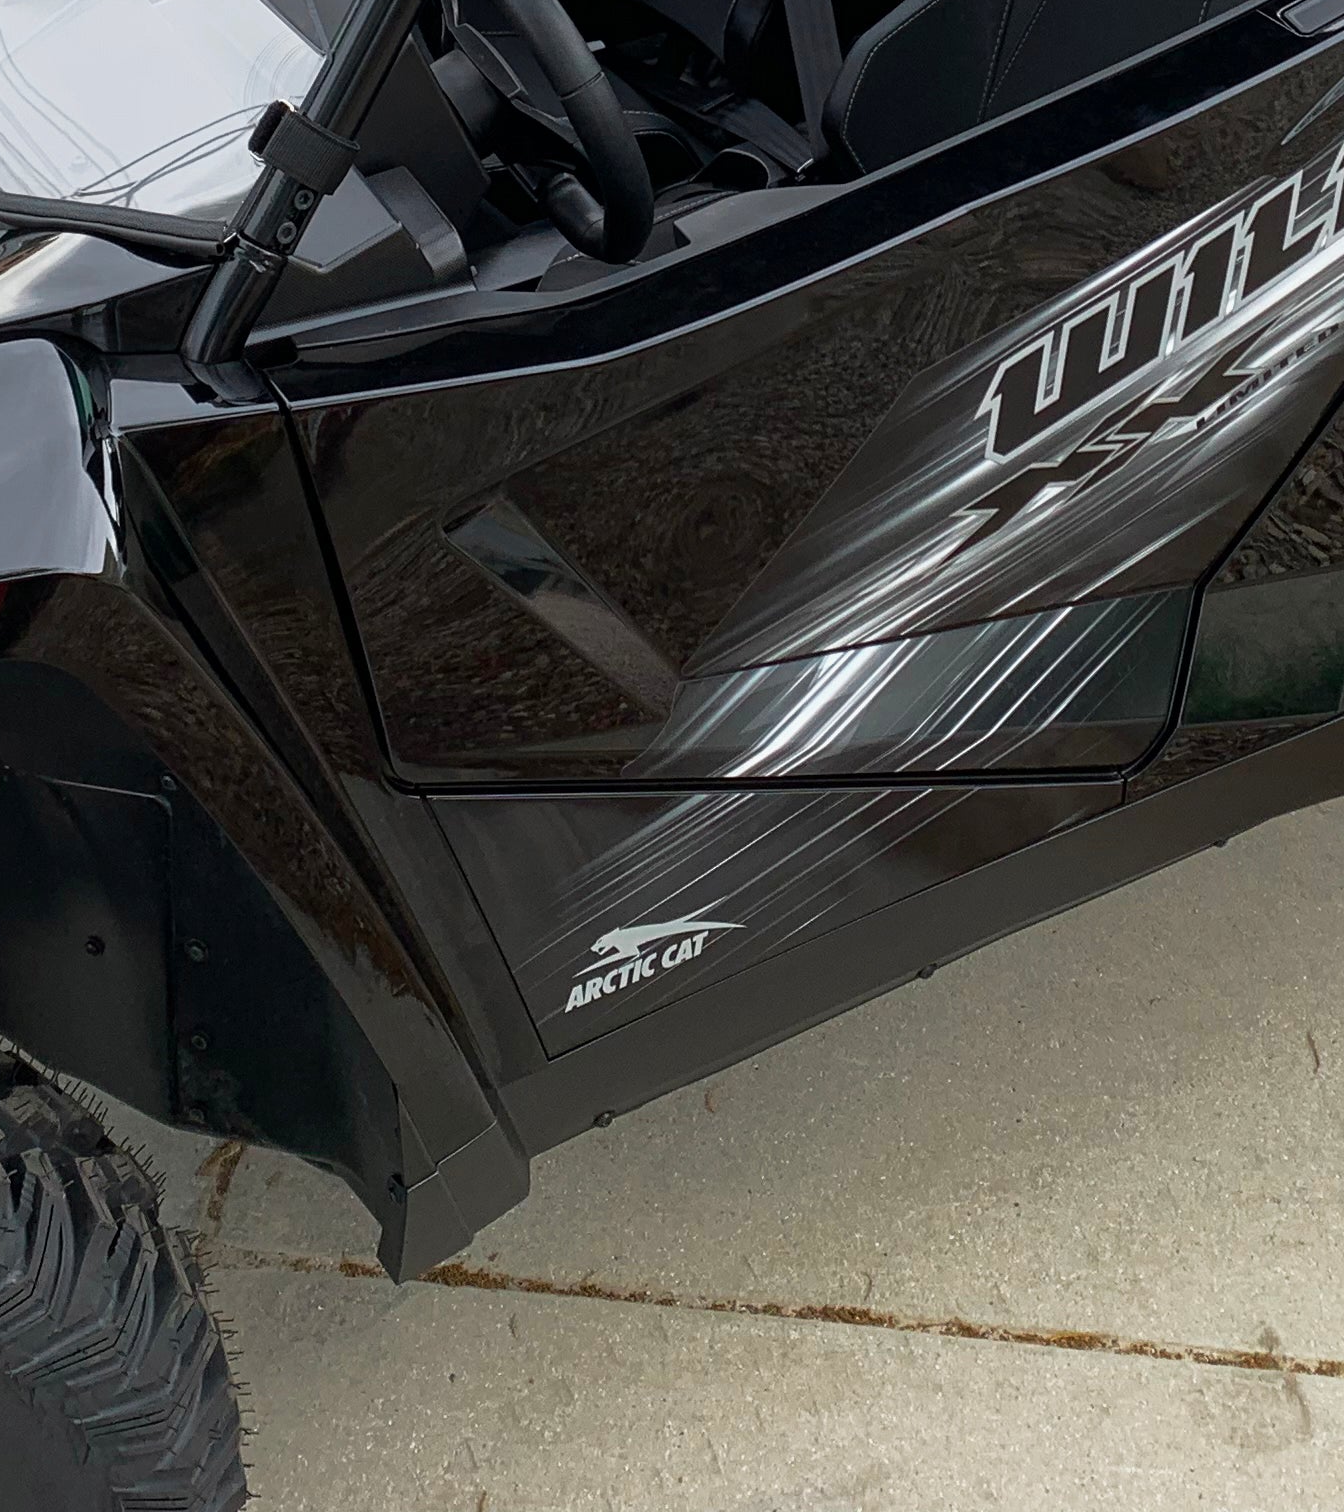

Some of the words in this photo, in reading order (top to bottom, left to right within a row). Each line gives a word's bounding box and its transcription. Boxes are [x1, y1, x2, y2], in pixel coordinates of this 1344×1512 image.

[1195, 322, 1340, 431] LIMITED
[564, 952, 657, 1014] ARCTIC
[661, 930, 709, 969] CAT
